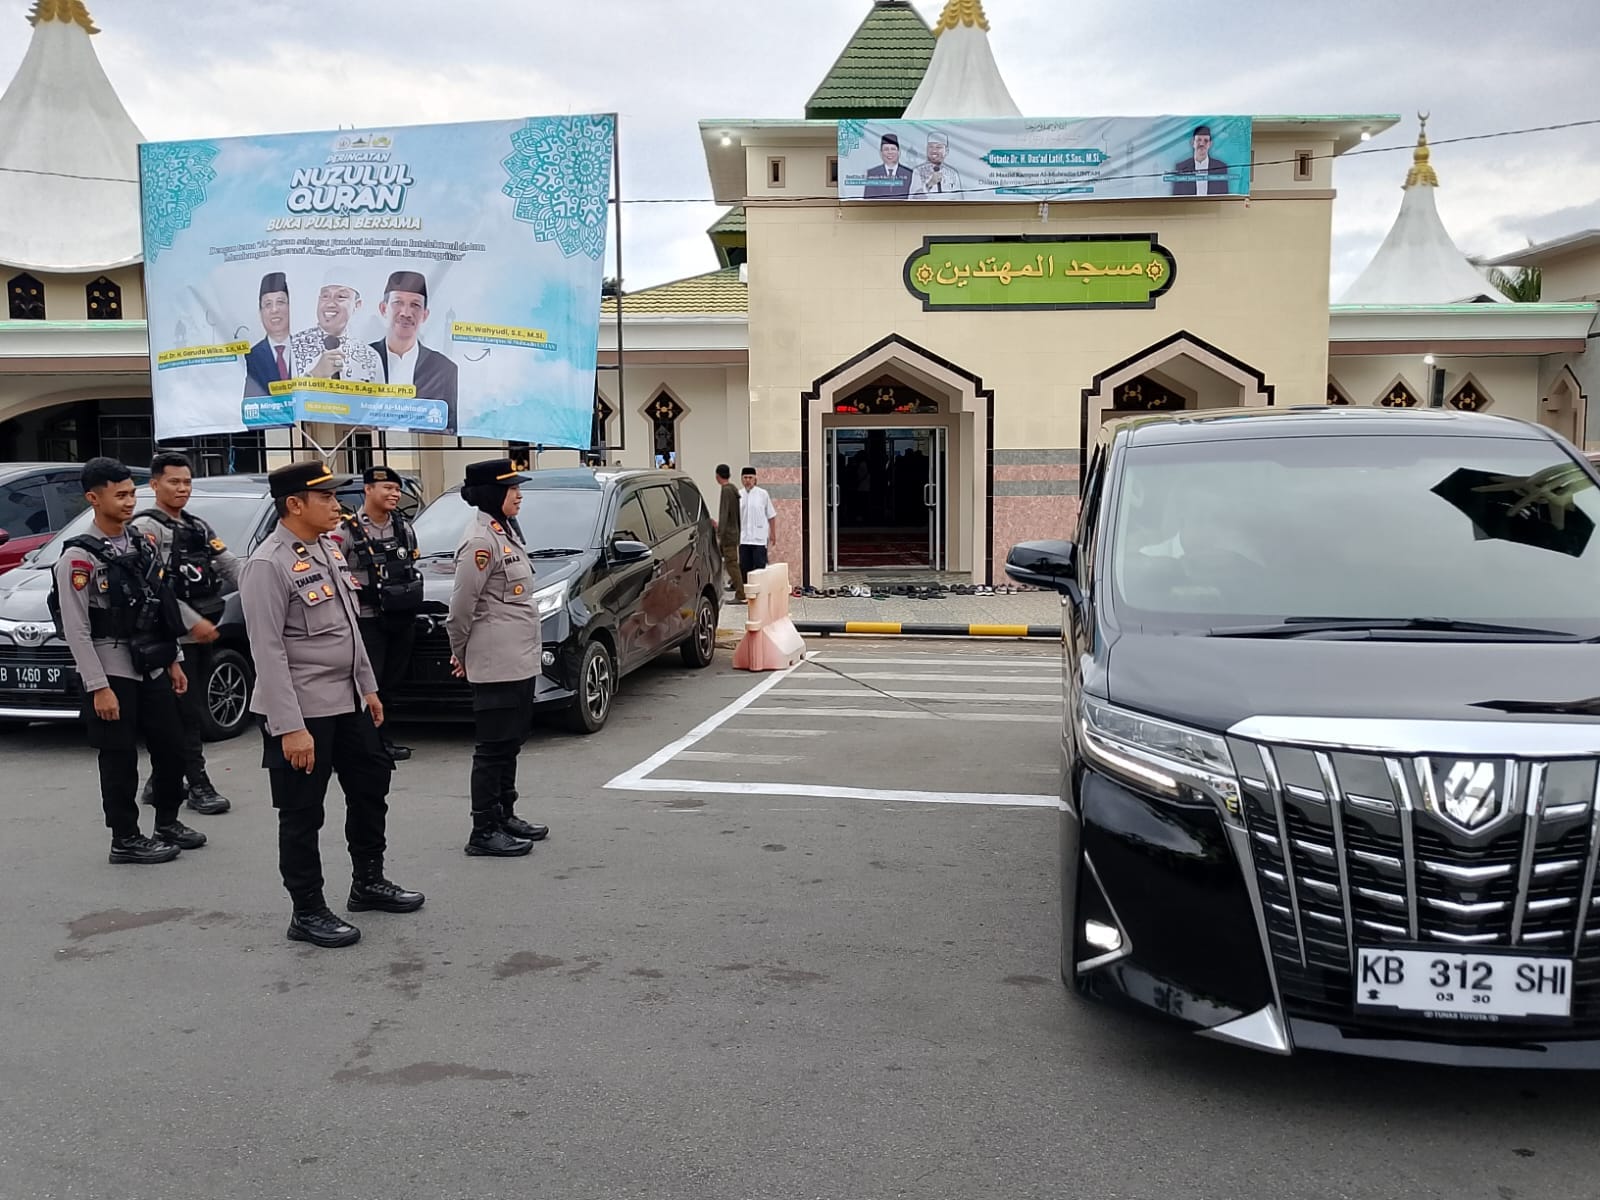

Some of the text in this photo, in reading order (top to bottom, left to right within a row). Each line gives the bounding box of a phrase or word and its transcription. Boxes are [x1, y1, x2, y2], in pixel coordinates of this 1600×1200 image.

[326, 152, 391, 163] PERINGATAN
[290, 164, 413, 188] NUZULUL
[287, 185, 404, 213] QURAN
[340, 205, 350, 217] &
[267, 217, 422, 231] BUKA PUASA BERSAMA
[936, 254, 1143, 288] مسجد المهتدين
[454, 324, 464, 332] Dr.
[474, 327, 510, 336] Wahyudi,
[183, 348, 206, 357] Garuda
[16, 668, 41, 682] 1460
[47, 668, 61, 682] SP
[1362, 955, 1567, 995] KB 312 SHI
[1436, 992, 1491, 1004] 03 30
